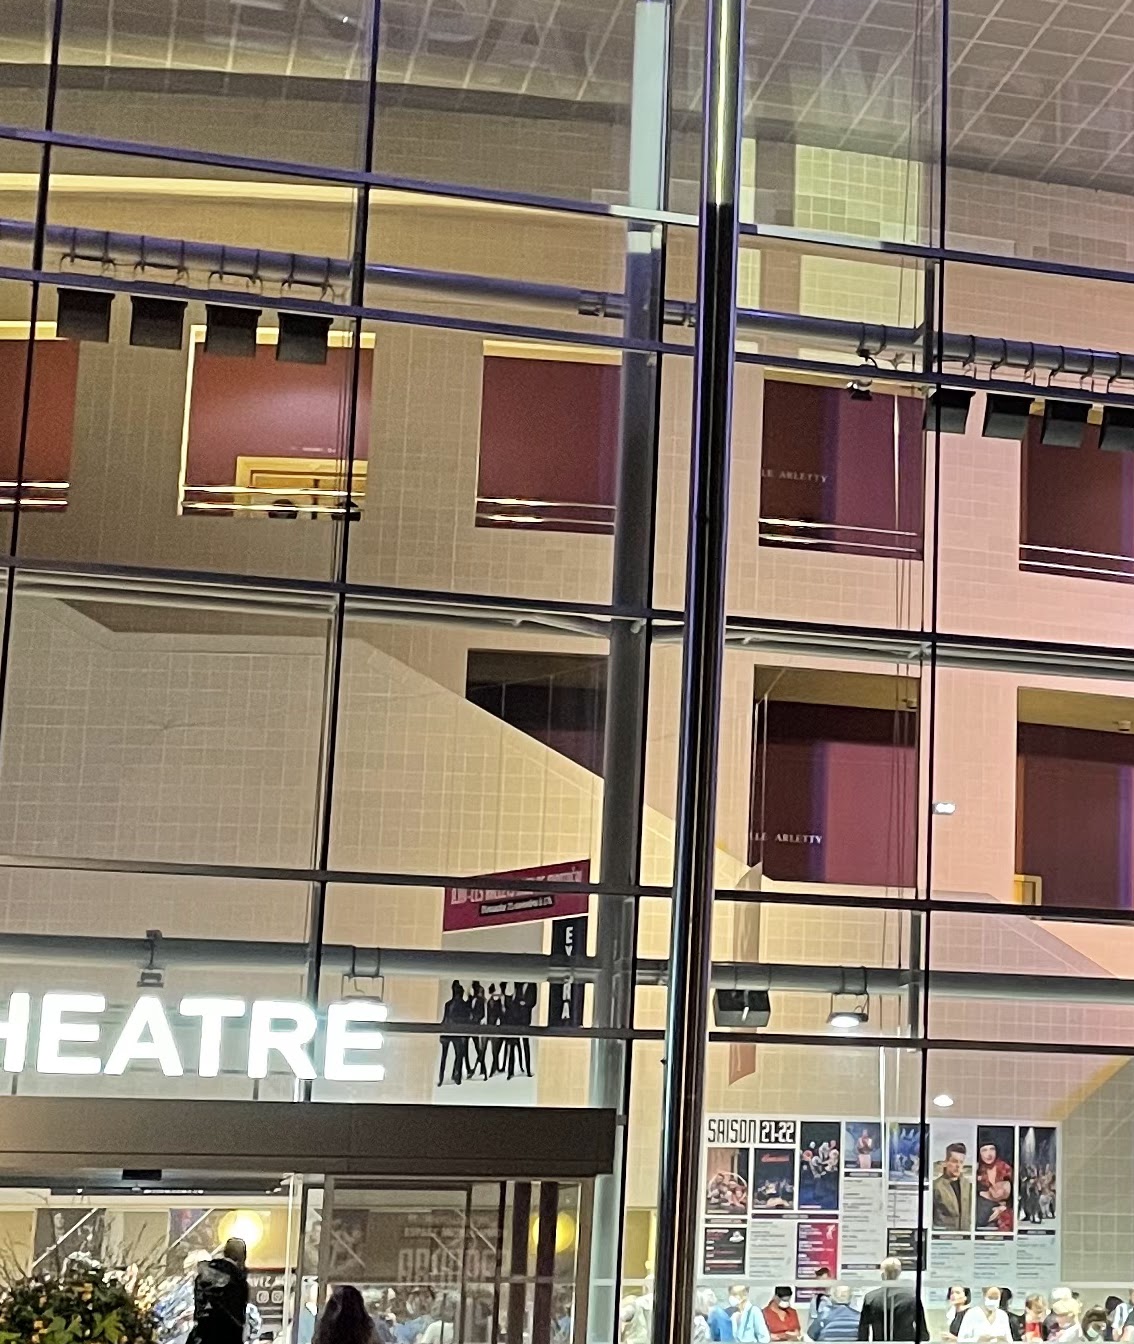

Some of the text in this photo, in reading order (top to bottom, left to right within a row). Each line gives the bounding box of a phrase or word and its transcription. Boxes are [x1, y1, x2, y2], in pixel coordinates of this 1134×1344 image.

[779, 470, 828, 483] ARLETTY
[775, 833, 822, 844] ARLETTY
[707, 1118, 795, 1144] SAISON 21-22
